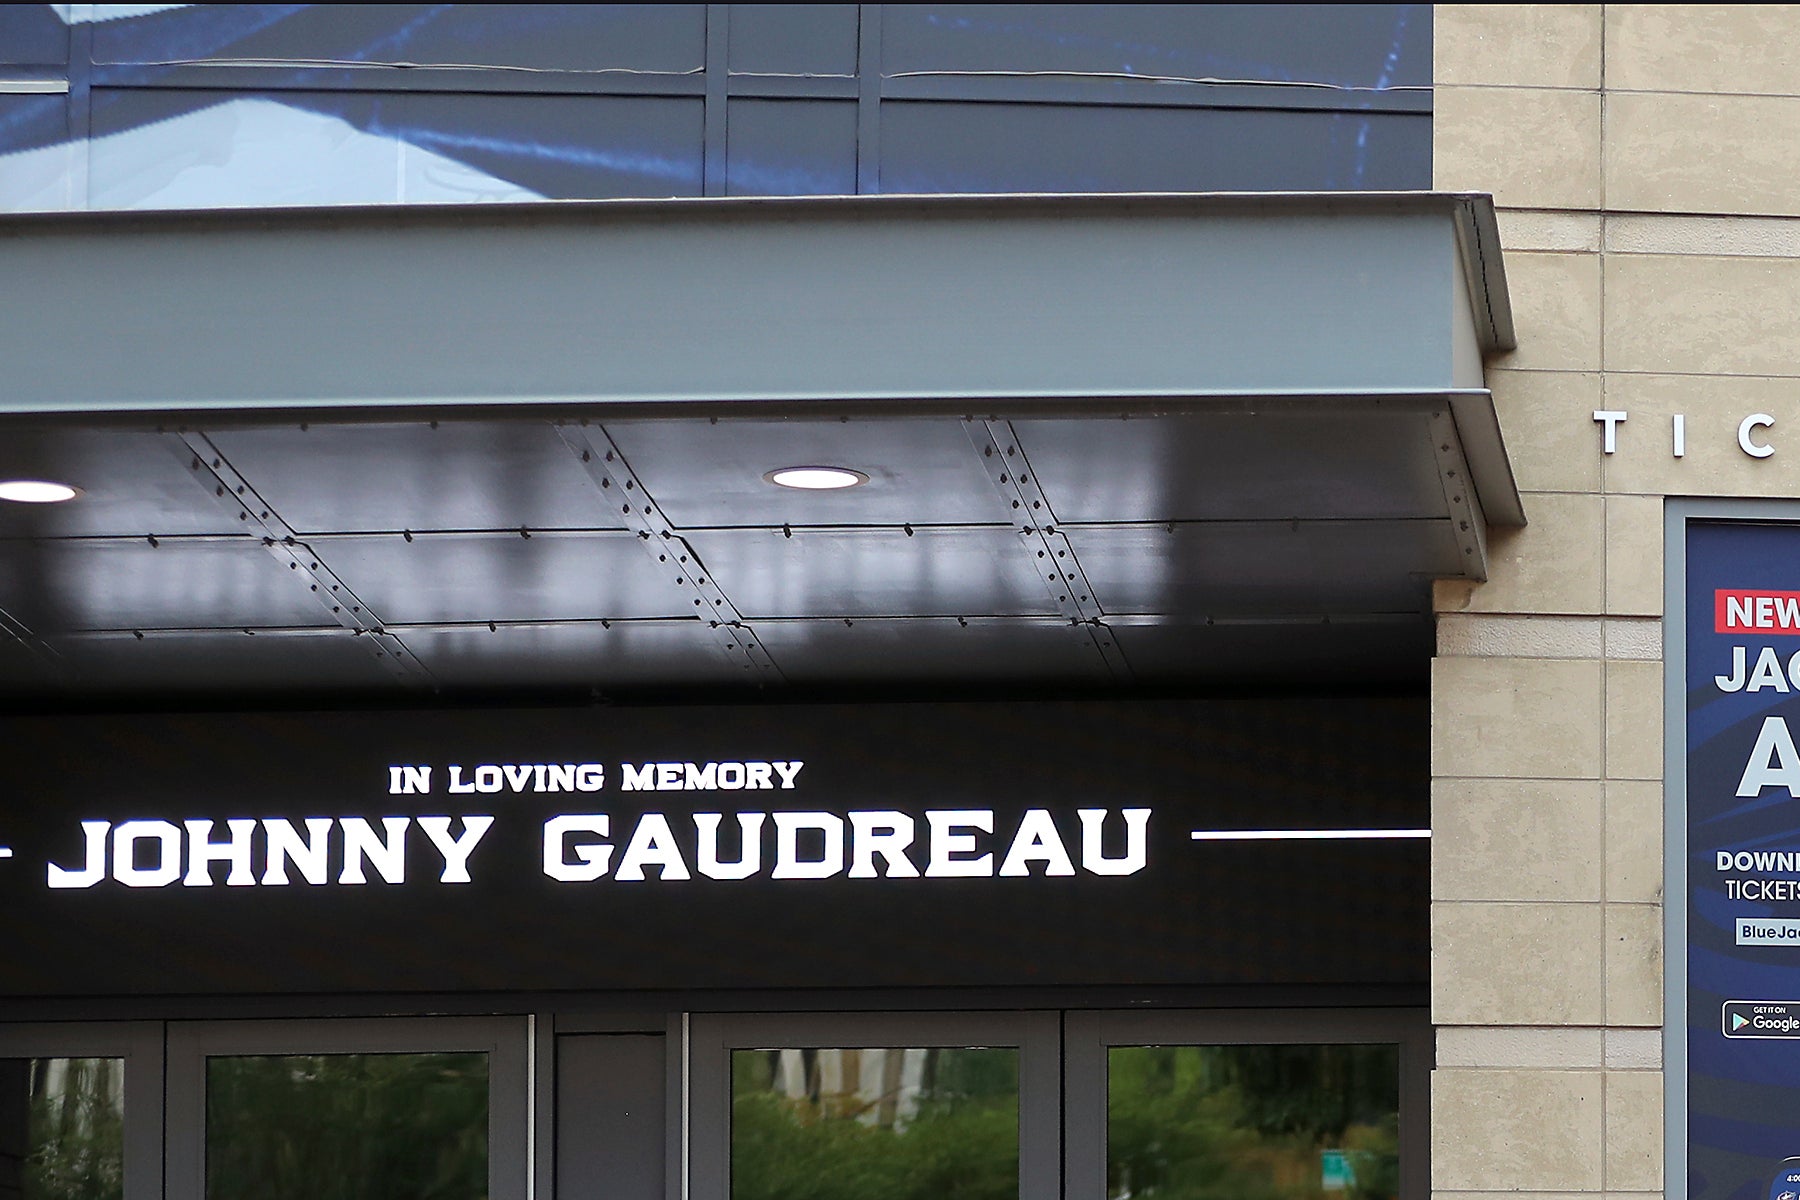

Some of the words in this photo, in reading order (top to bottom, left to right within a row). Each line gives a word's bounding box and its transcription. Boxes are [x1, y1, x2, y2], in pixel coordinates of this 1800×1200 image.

[388, 766, 432, 794] IN
[448, 764, 605, 794] LOVING
[621, 761, 804, 791] MEMORY
[47, 815, 495, 889] JOHNNY
[543, 808, 1152, 882] GAUDREAU
[1753, 1006, 1768, 1014] GET
[1752, 1016, 1799, 1032] Google
